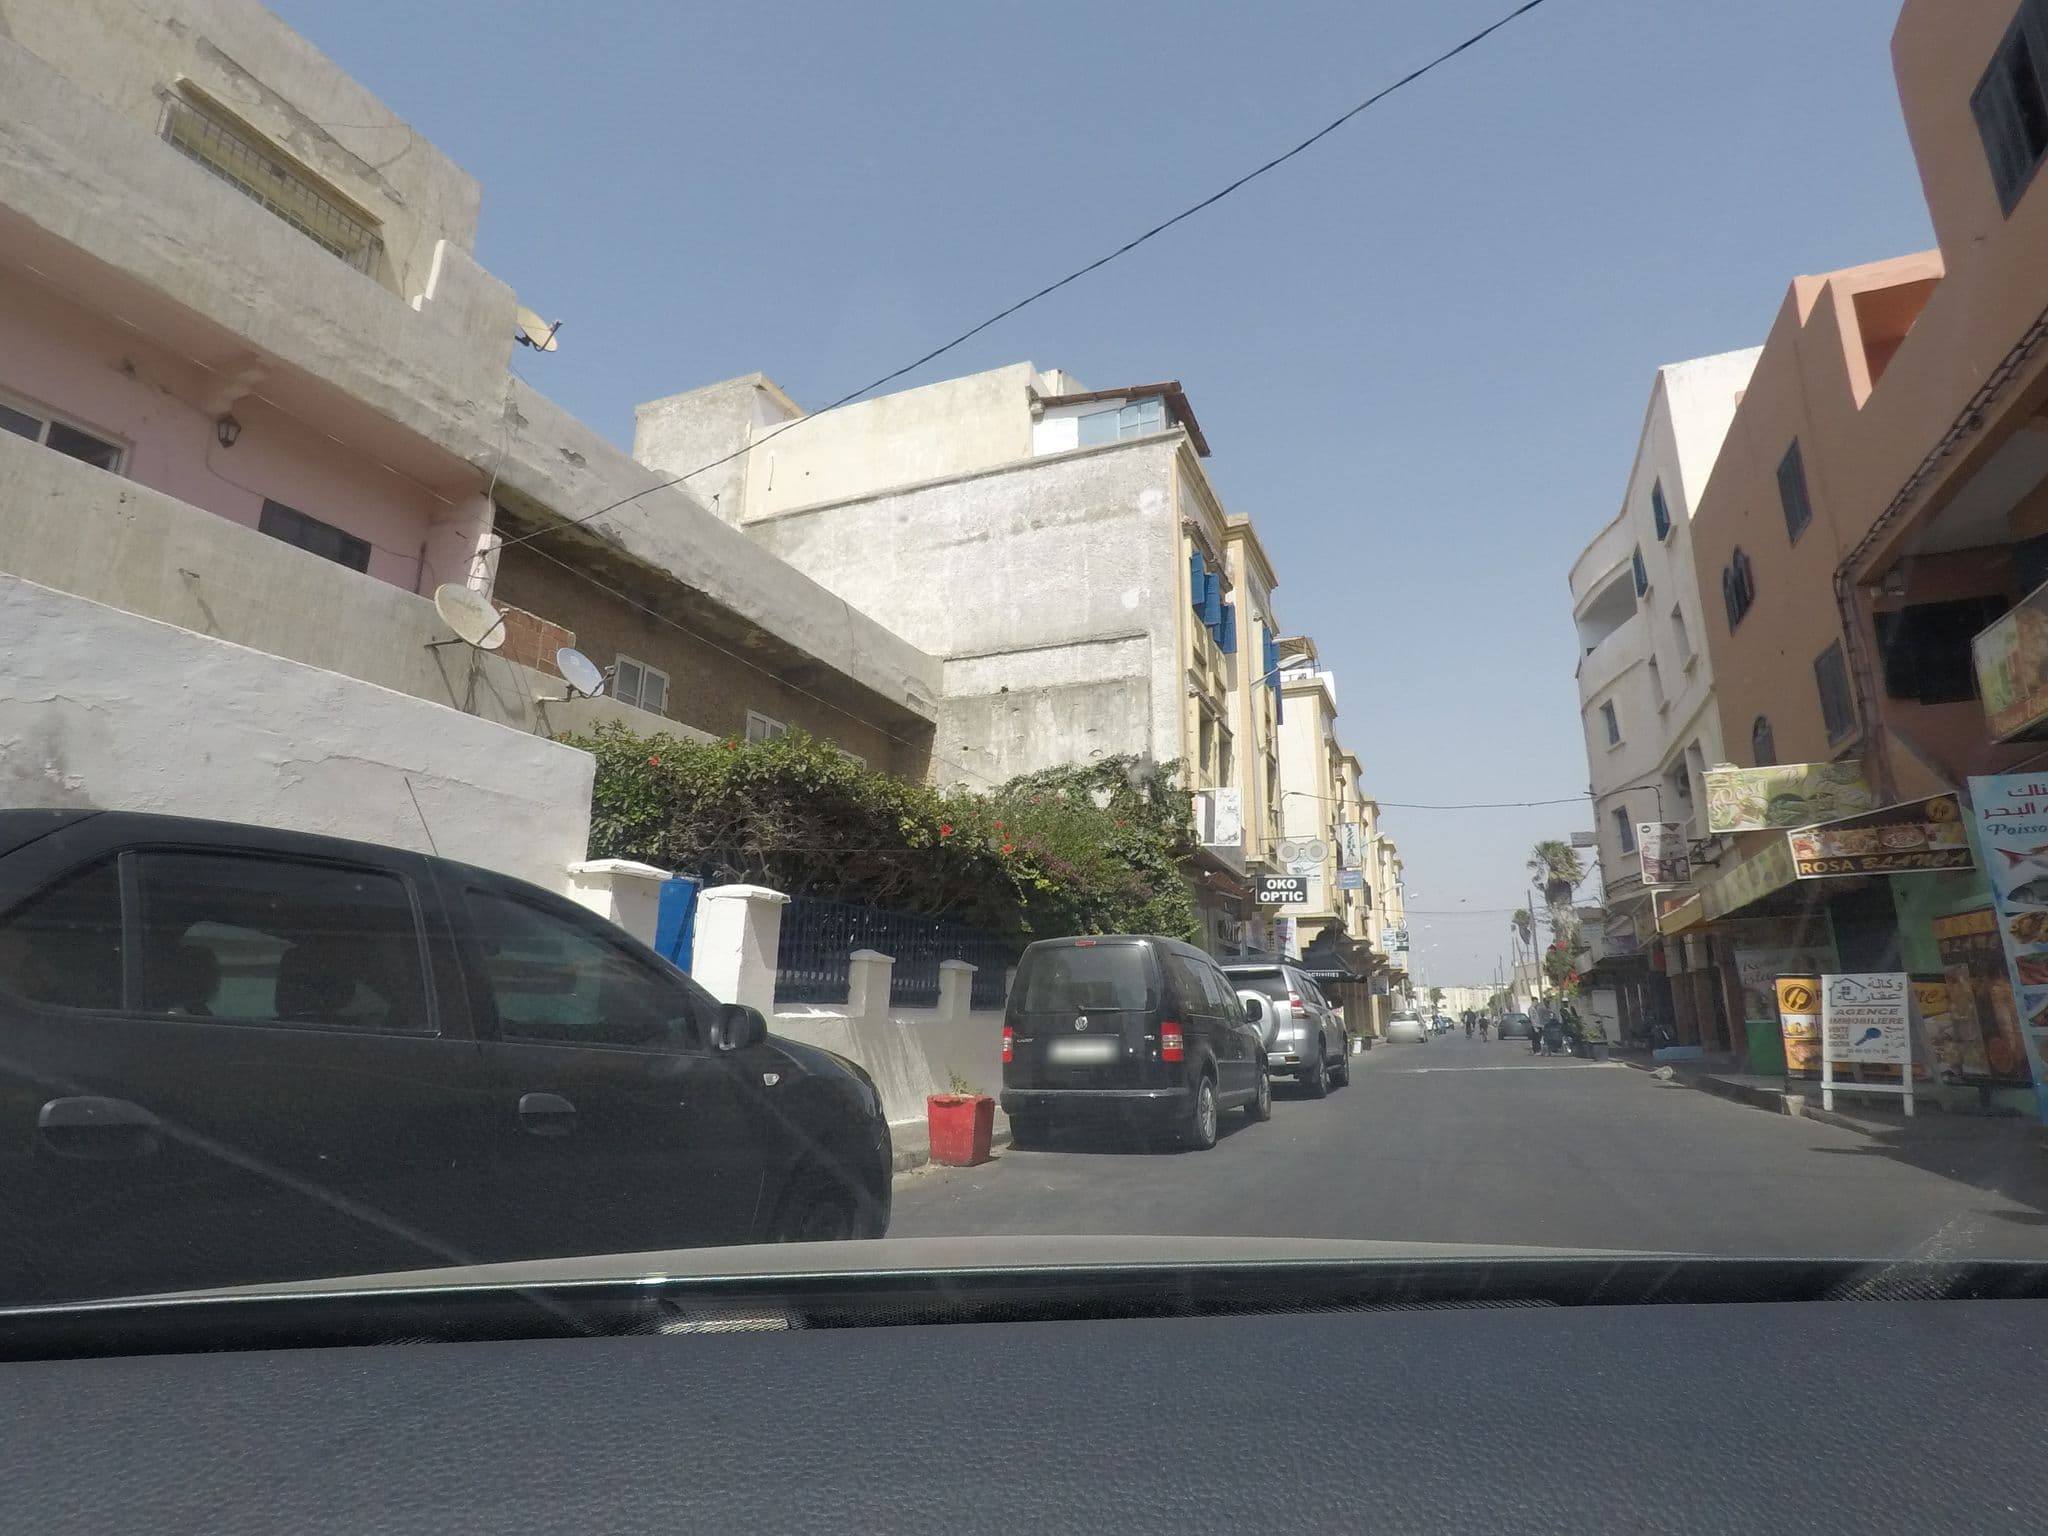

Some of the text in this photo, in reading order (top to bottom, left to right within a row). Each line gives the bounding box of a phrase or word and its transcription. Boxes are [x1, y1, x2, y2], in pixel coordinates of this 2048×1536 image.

[1984, 802, 2036, 820] البحر
[1986, 823, 2048, 836] Poisso
[1800, 852, 1968, 875] ROSA BLANCA
[1266, 879, 1298, 890] OKO
[1260, 891, 1304, 902] OPTIC
[1834, 1008, 1899, 1016] AGENCE
[1828, 1017, 1905, 1025] IMMOBILIERE
